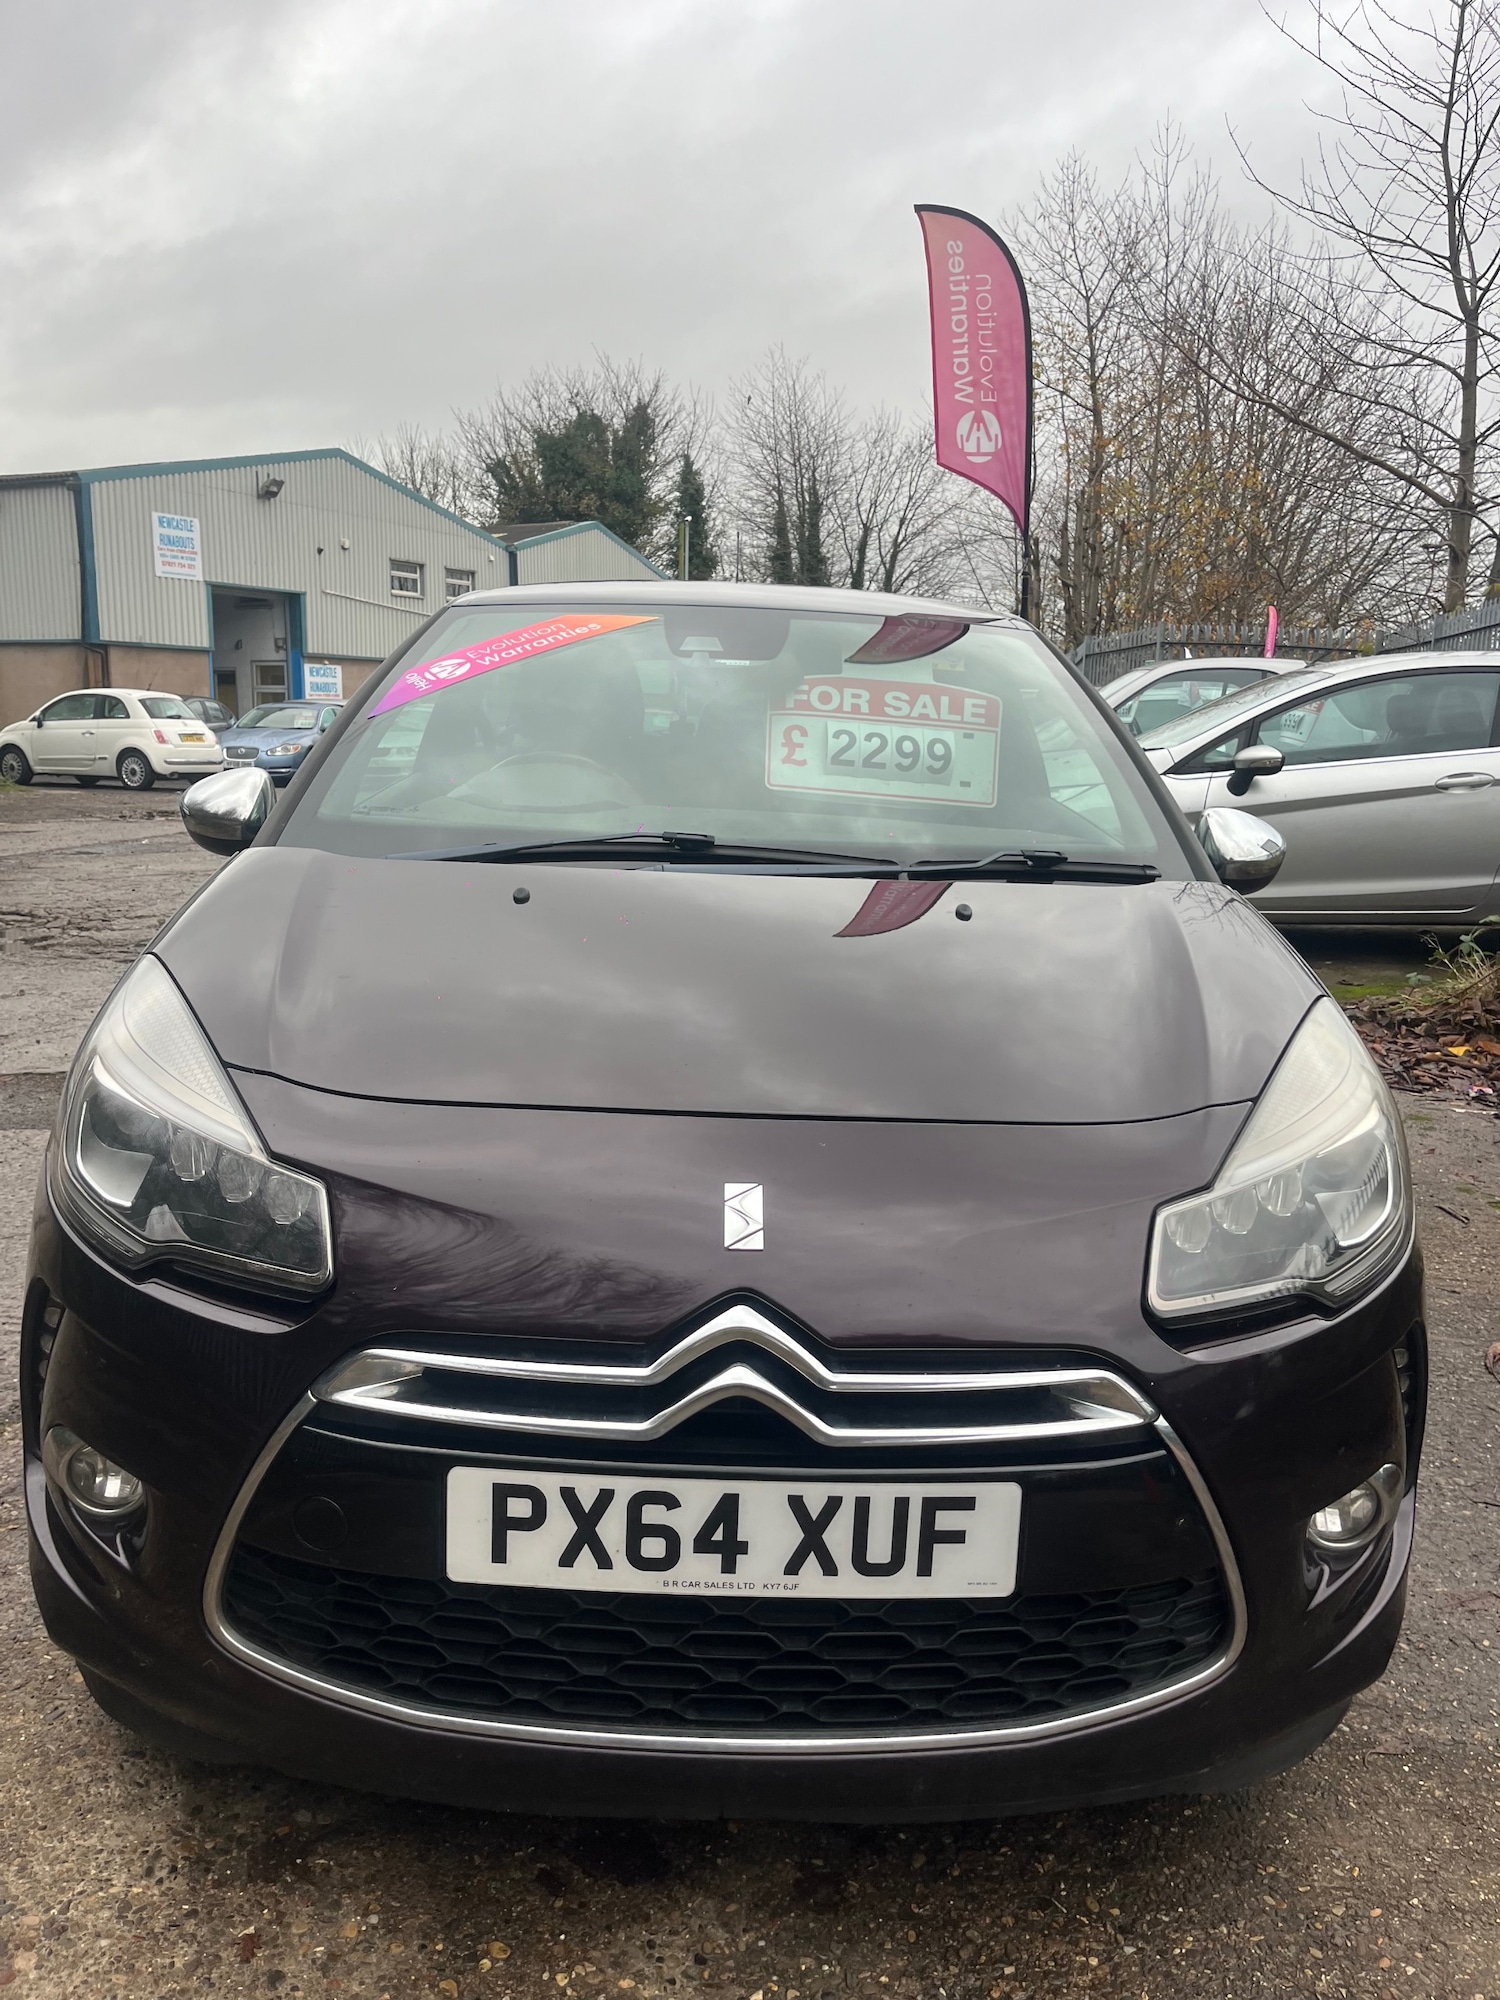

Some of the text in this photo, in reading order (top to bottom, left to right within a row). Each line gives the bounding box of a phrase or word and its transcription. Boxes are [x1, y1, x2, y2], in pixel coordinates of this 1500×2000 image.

[158, 515, 194, 533] NEWCASTLE
[159, 533, 195, 550] RUNABOUTS
[466, 623, 566, 659] Evolution
[475, 623, 601, 666] Warranties
[309, 666, 337, 678] NEWCASTLE
[405, 672, 433, 692] Hello
[310, 681, 337, 694] RUNABOUTS
[785, 685, 988, 724] FOR SALE
[781, 724, 952, 775] £ 2299
[491, 1482, 976, 1578] PX64 XUF
[672, 1580, 679, 1588] R
[681, 1580, 701, 1588] CAR
[704, 1581, 734, 1589] SALES
[783, 1583, 800, 1591] 6JF
